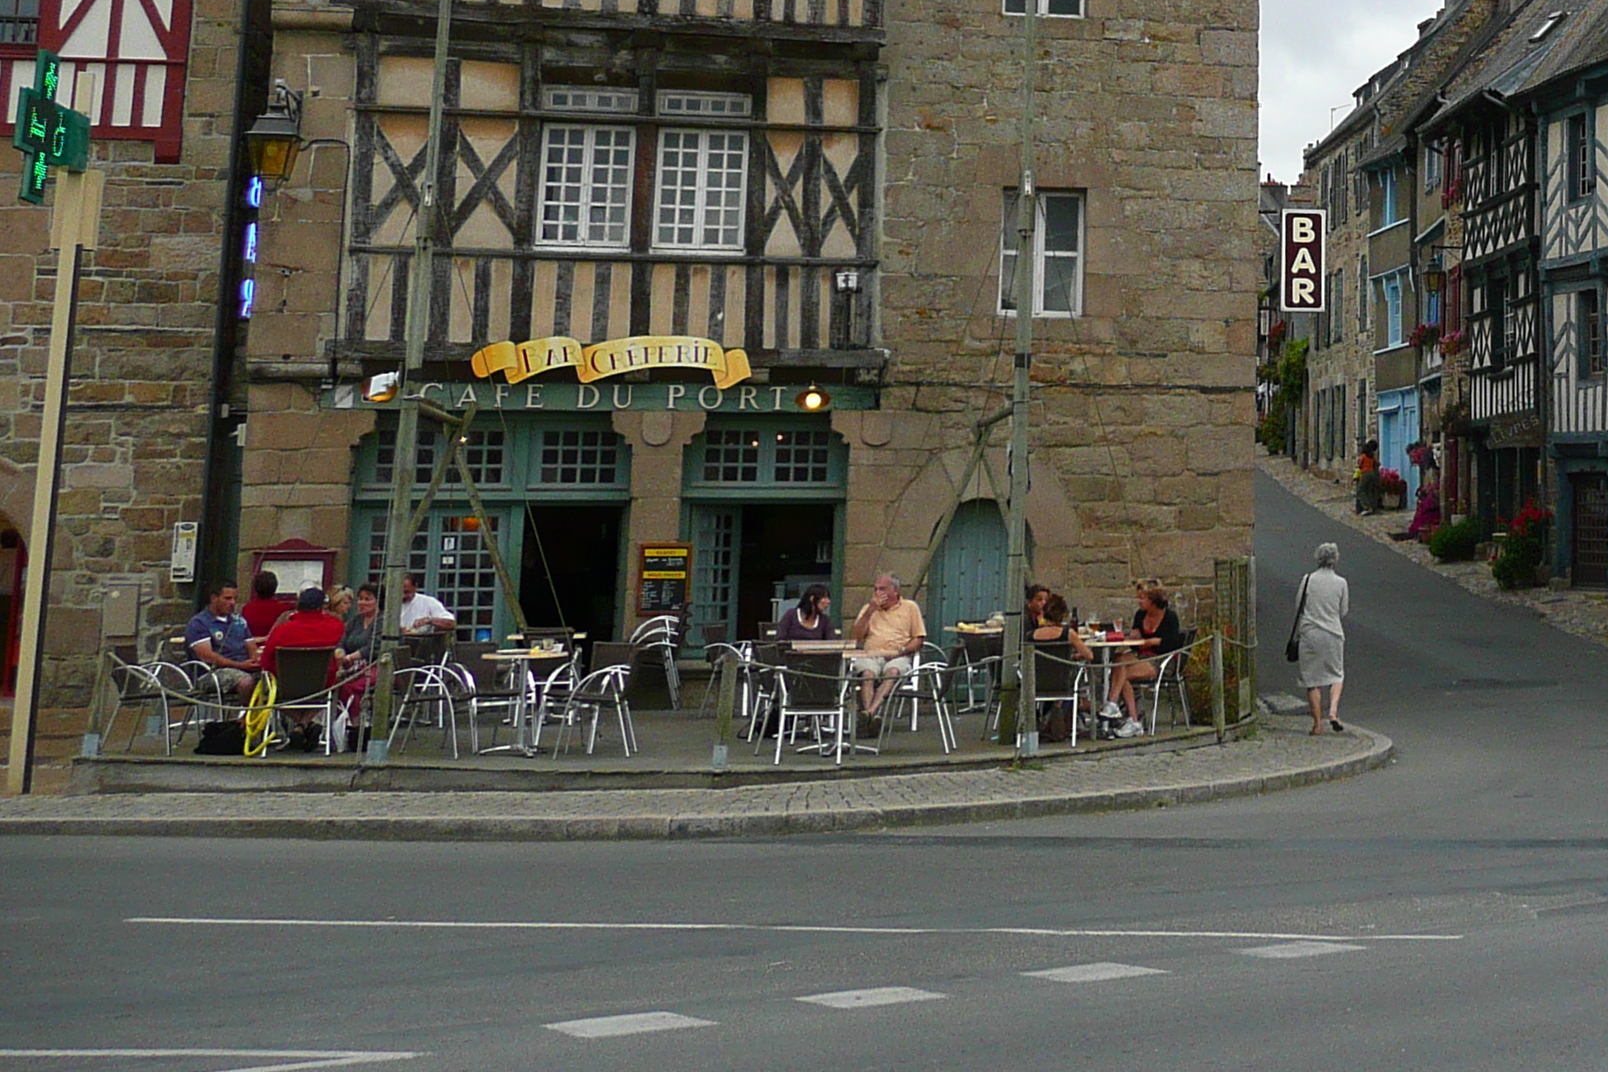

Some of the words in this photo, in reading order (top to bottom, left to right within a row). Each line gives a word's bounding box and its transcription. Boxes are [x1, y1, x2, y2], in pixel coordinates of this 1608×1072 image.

[1291, 216, 1316, 304] BAR
[521, 344, 581, 374] BAR
[576, 384, 634, 409] DU
[666, 384, 788, 411] PORT
